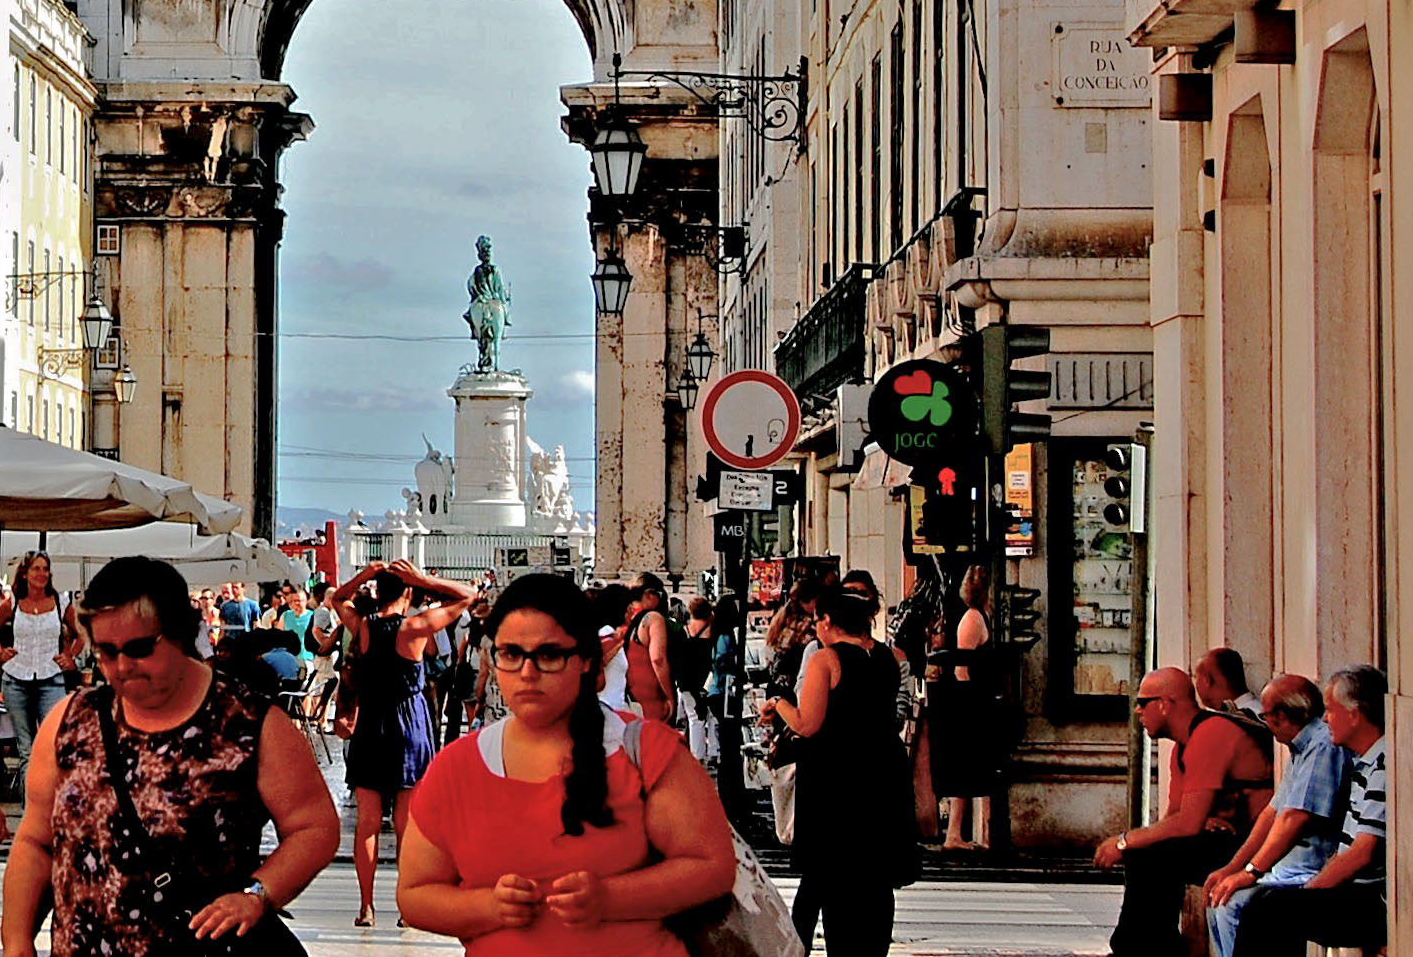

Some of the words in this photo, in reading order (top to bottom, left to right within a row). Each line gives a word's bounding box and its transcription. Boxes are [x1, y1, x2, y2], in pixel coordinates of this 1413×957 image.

[1090, 40, 1122, 54] RUA
[1096, 58, 1116, 72] DA
[720, 525, 745, 537] MB
